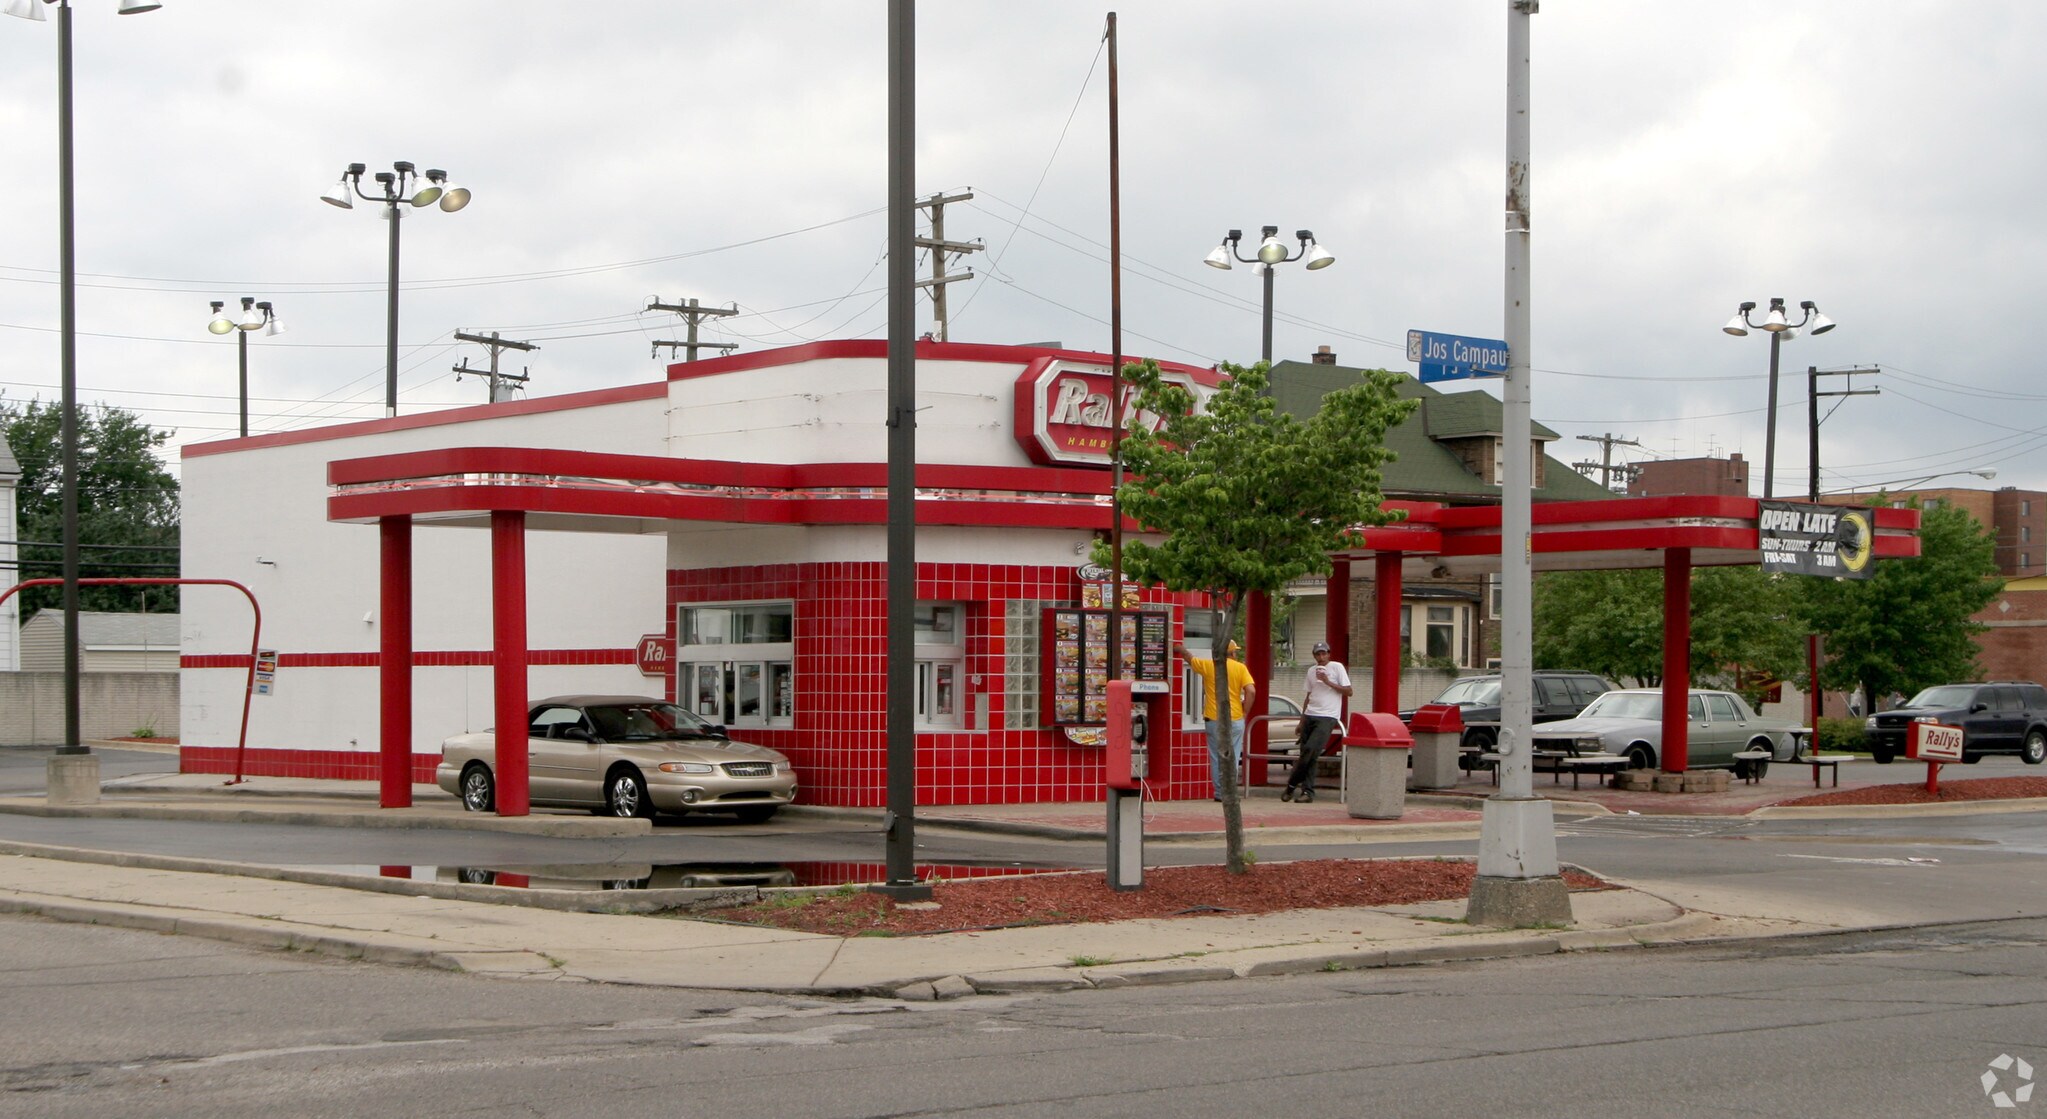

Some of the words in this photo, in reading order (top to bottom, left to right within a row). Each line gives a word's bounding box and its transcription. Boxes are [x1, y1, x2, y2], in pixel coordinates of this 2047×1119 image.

[1425, 337, 1447, 360] Jos
[1453, 340, 1507, 369] Campau
[1761, 510, 1800, 532] OPEN
[1803, 513, 1836, 533] LATE
[1761, 538, 1810, 551] SUN-THURS
[1764, 552, 1796, 564] FRI-SAT
[1139, 681, 1159, 690] Phone
[1926, 730, 1960, 750] Rally's
